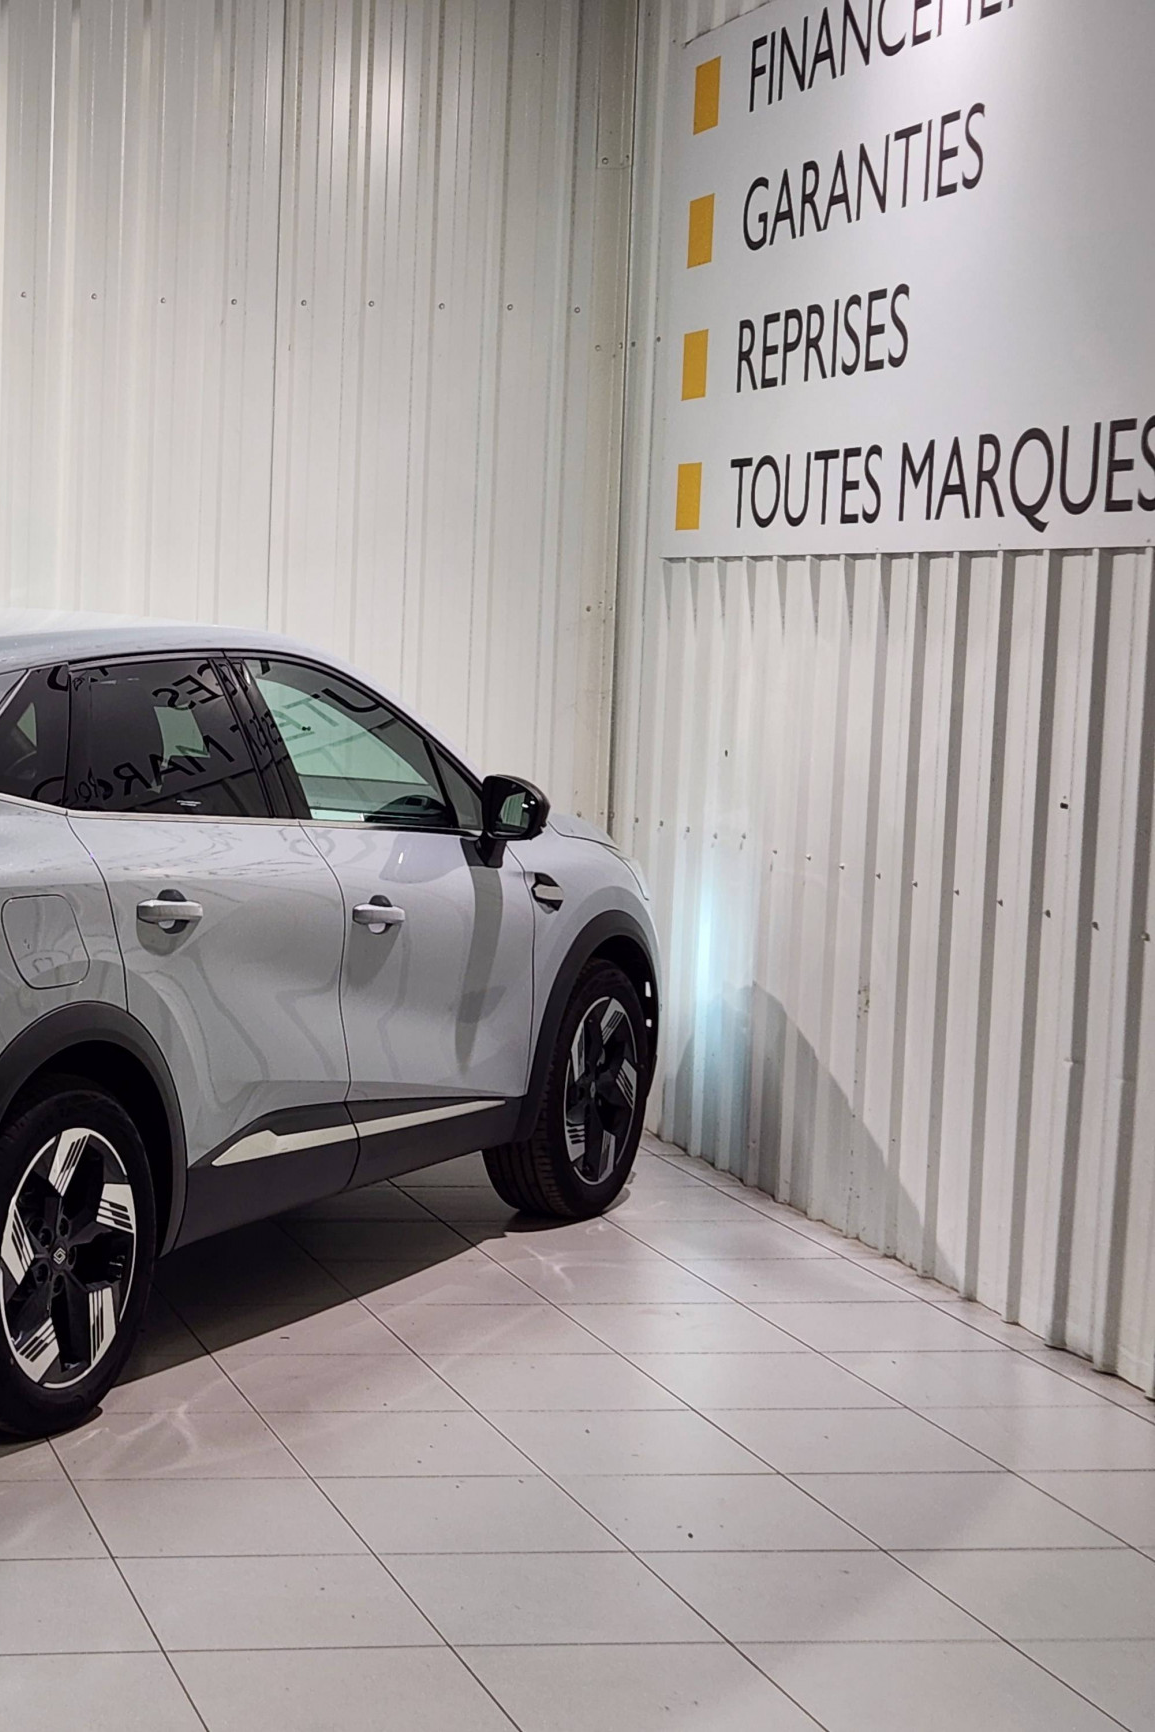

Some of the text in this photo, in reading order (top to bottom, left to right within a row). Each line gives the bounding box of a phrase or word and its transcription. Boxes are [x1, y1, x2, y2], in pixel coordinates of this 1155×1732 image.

[743, 102, 986, 251] GARANTIES
[737, 284, 910, 393] REPRISES
[731, 414, 1155, 533] TOUTES MARQUES
